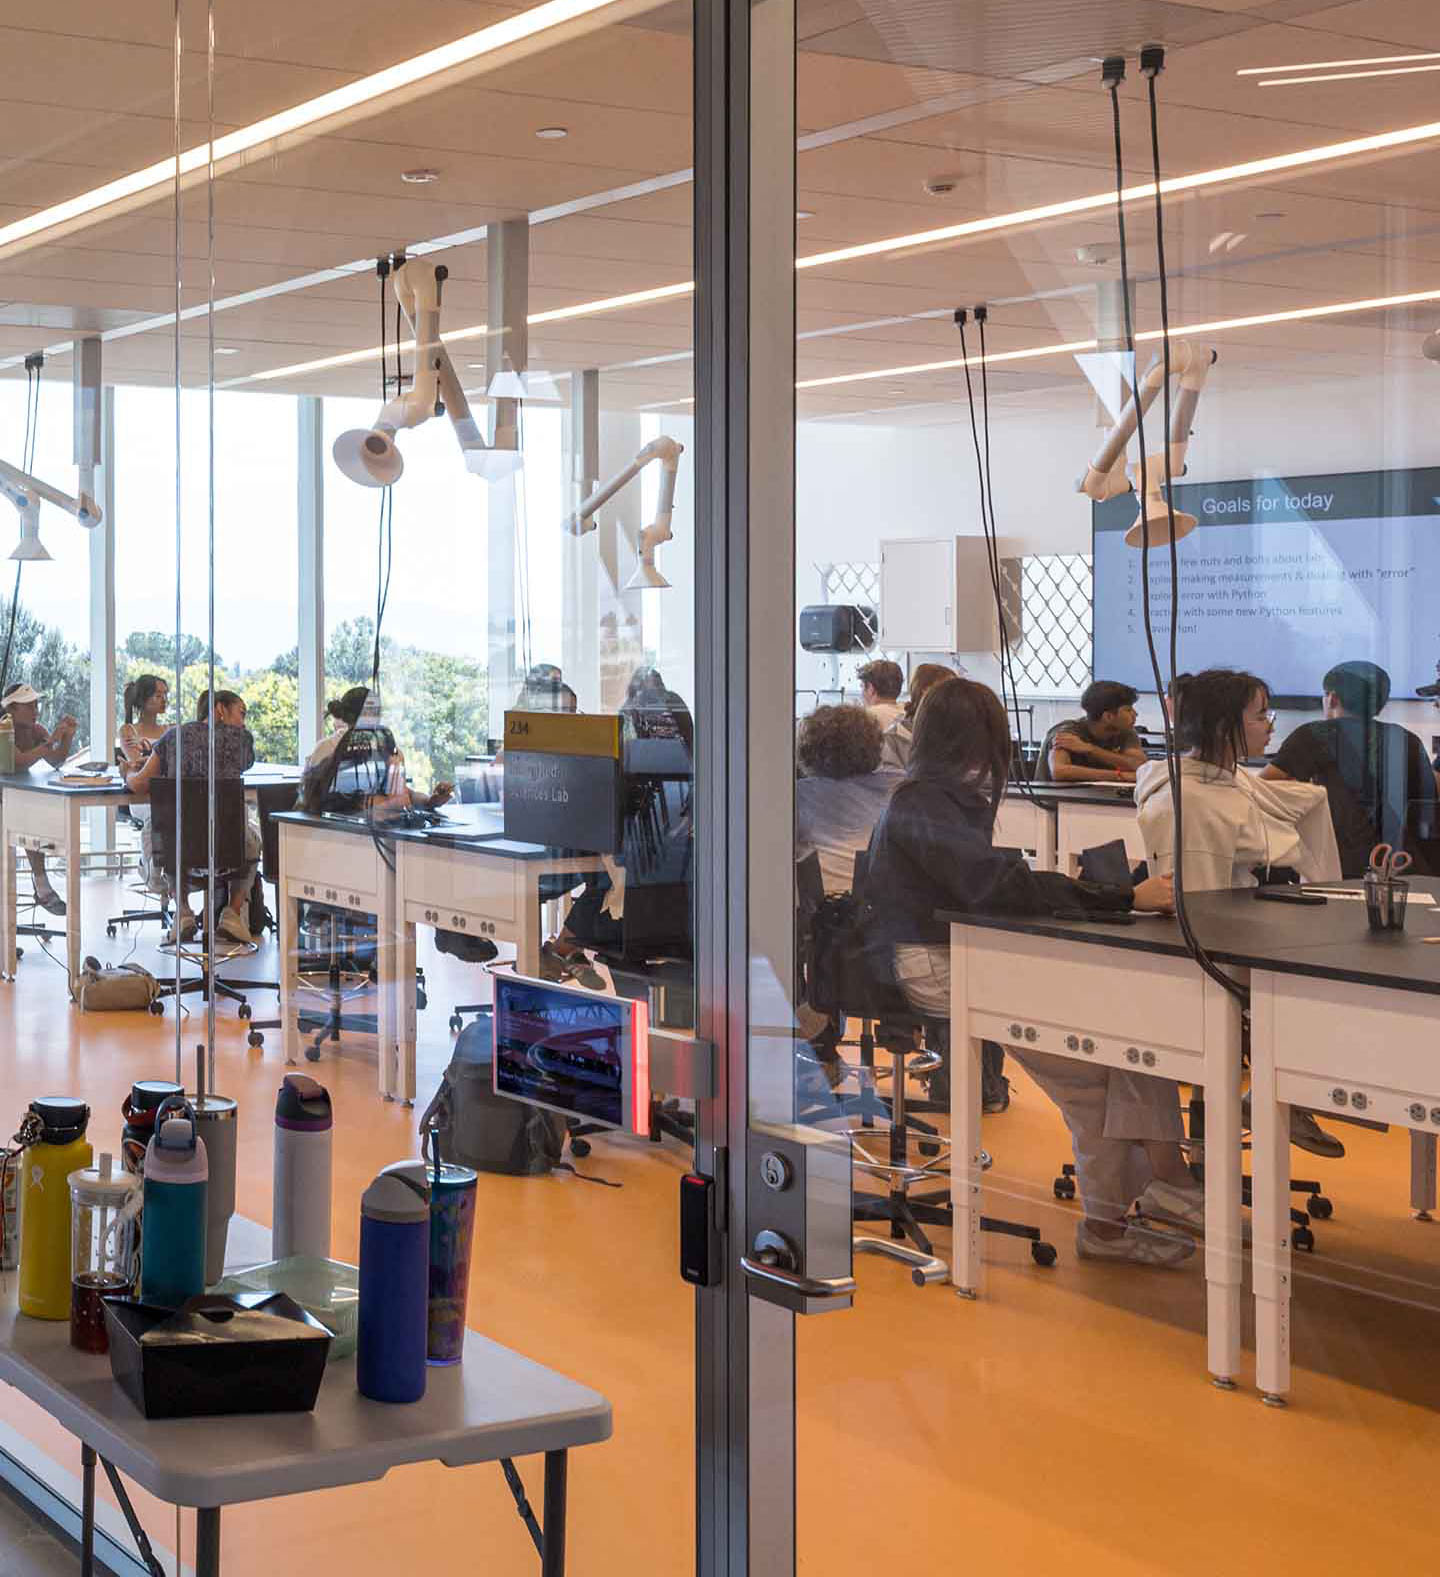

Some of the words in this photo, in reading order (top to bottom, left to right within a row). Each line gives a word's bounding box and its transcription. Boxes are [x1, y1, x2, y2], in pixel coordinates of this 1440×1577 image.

[1202, 497, 1251, 514] Goals
[1256, 494, 1280, 511] for
[1285, 492, 1334, 511] today
[1180, 557, 1198, 567] few
[1200, 557, 1221, 567] nuts
[1223, 556, 1242, 566] and
[1244, 554, 1270, 565] bolts
[1272, 553, 1303, 564] about
[1181, 574, 1216, 586] making
[1218, 571, 1293, 583] measurements
[1349, 568, 1373, 580] with
[1181, 592, 1205, 601] error
[1207, 590, 1229, 601] with
[1231, 588, 1267, 602] Python
[1183, 606, 1205, 617] with
[1206, 608, 1234, 617] some
[1235, 608, 1258, 617] new
[1259, 605, 1296, 618] Python
[1298, 605, 1343, 617] features
[510, 720, 529, 735] 234
